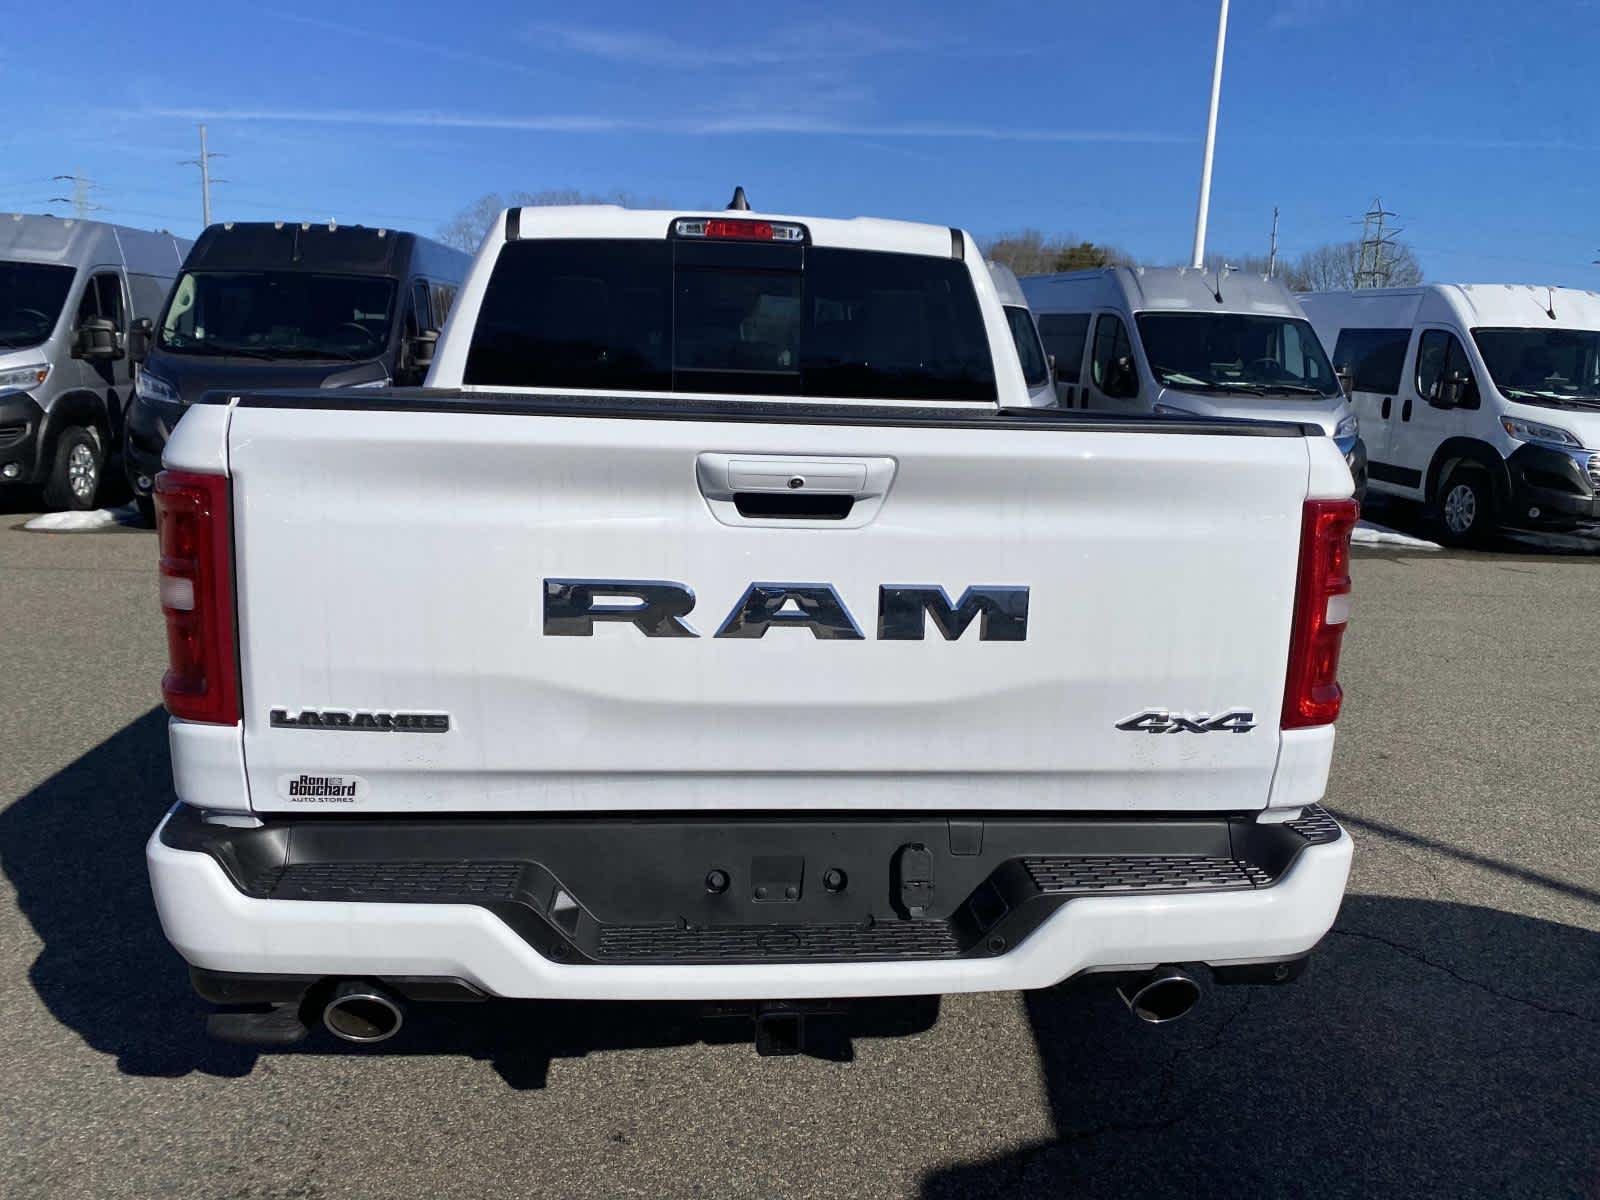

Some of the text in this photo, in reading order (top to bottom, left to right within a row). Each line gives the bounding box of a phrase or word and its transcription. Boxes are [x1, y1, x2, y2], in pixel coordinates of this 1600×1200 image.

[542, 577, 1031, 642] RAM
[289, 779, 357, 797] Bouchard
[300, 775, 324, 786] Ron
